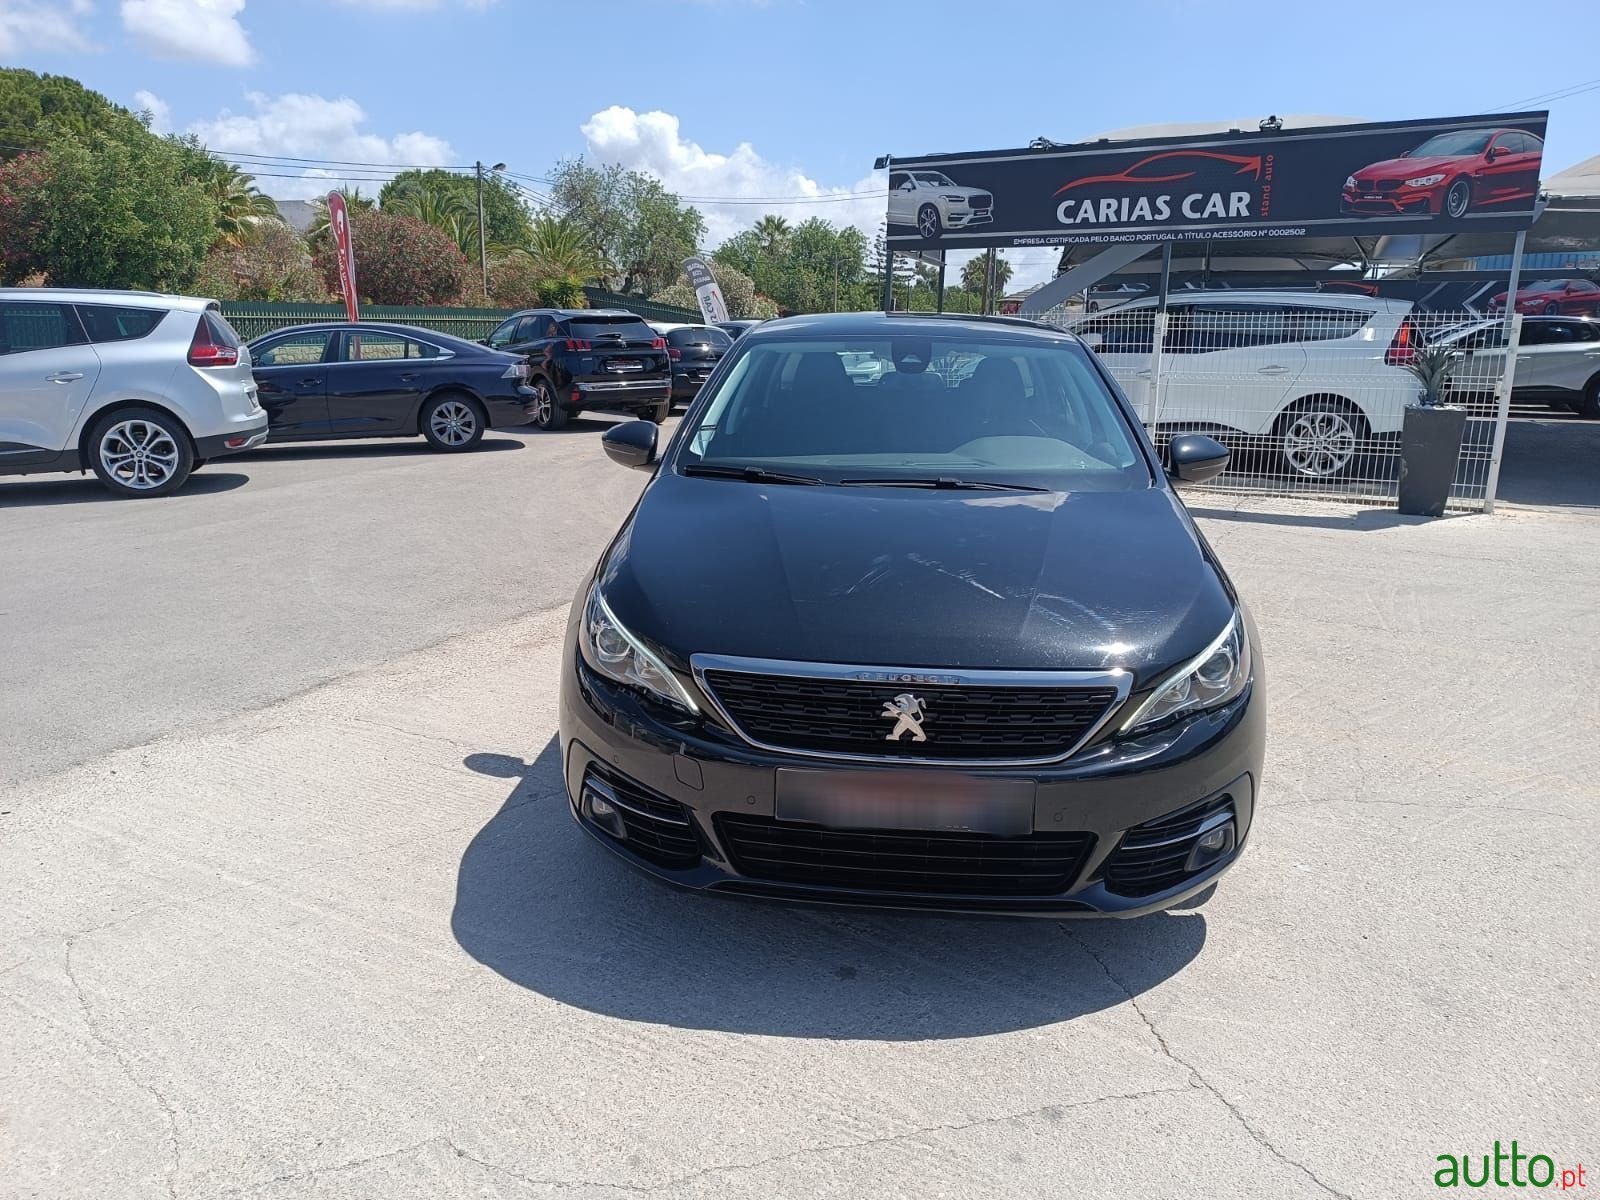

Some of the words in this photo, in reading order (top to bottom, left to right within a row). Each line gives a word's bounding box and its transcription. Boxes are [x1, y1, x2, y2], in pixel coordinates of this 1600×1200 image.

[1265, 154, 1274, 181] auto
[1056, 195, 1171, 224] CARIAS
[1181, 191, 1251, 219] CAR
[1261, 184, 1272, 217] stand
[1045, 236, 1090, 244] CERTIFICADA
[1109, 234, 1135, 242] BANCO
[1136, 232, 1177, 241] PORTUGAL
[1184, 231, 1211, 239] TÍTULO
[1212, 230, 1257, 238] ACESSÓRIO
[1268, 228, 1306, 236] 0002502
